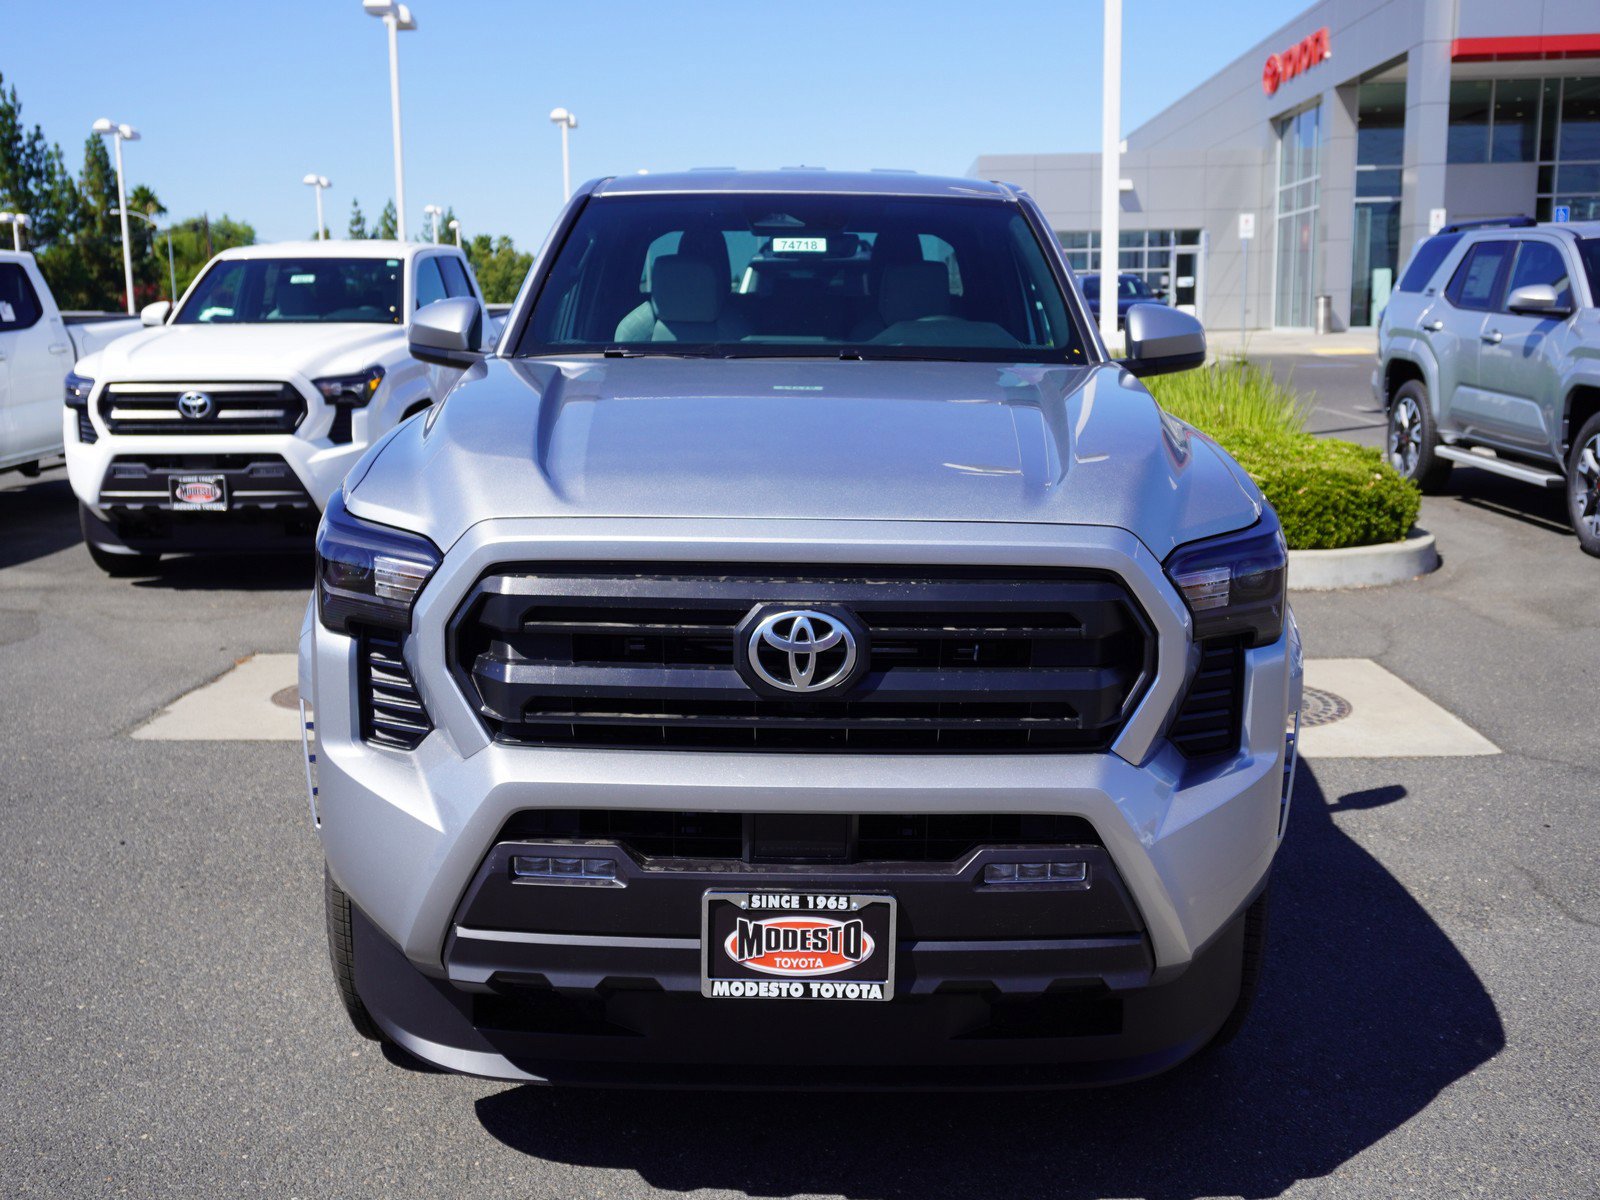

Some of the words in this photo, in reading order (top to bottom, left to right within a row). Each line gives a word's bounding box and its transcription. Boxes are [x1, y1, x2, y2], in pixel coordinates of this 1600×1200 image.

[781, 240, 818, 250] 74718
[751, 895, 800, 909] SINCE
[807, 896, 849, 910] 1965
[736, 917, 863, 961] MODESTO
[774, 957, 824, 969] TOYOTA
[712, 981, 804, 998] MODESTO
[810, 983, 883, 999] TOYOTA
